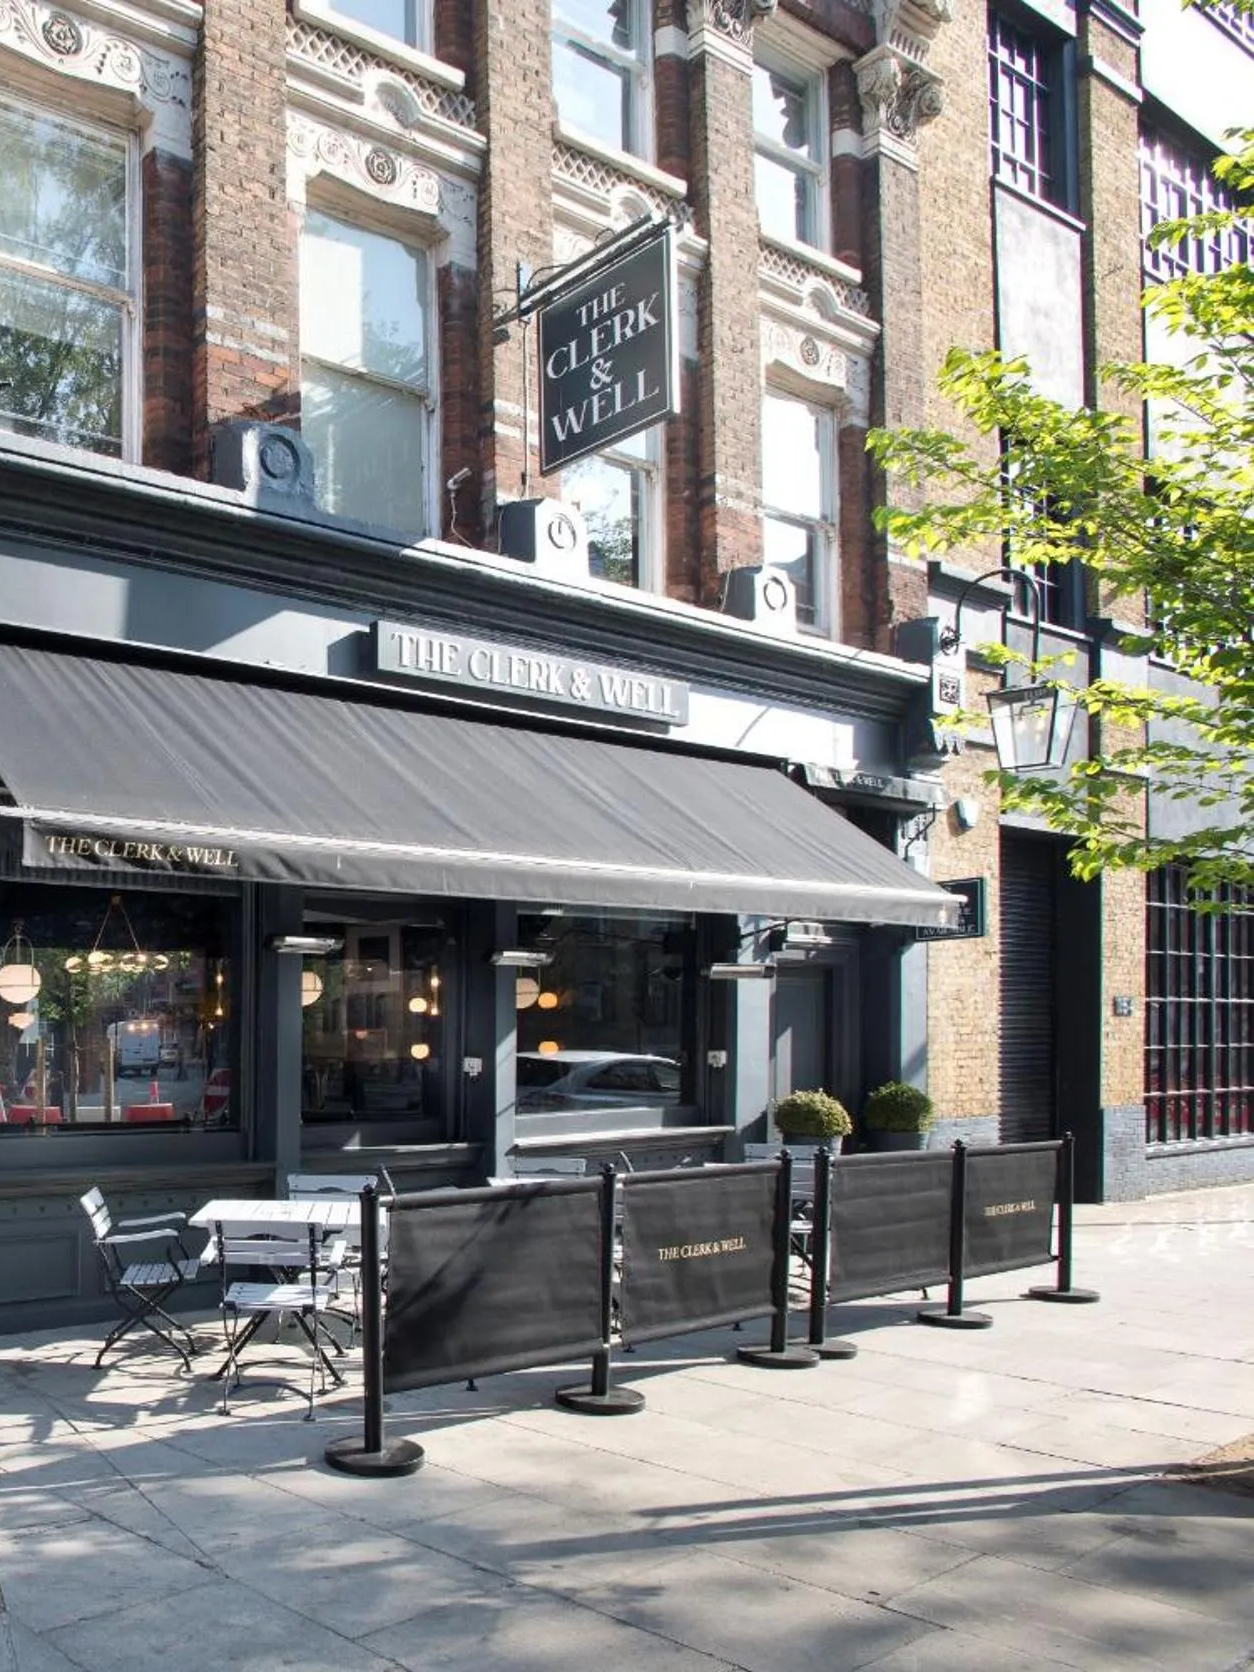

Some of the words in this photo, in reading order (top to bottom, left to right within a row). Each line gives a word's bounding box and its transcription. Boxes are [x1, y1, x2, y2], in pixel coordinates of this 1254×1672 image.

[577, 282, 625, 327] THE
[547, 292, 659, 379] CLERK
[590, 358, 613, 390] &
[552, 369, 659, 442] WELL
[391, 631, 461, 676] THE
[468, 650, 565, 697] CLERK
[570, 667, 591, 700] &
[598, 673, 680, 717] WELL
[46, 836, 91, 855] THE
[95, 839, 164, 861] CLERK
[166, 845, 183, 862] &
[186, 847, 239, 867] WELL
[658, 1247, 679, 1260] THE
[680, 1242, 712, 1258] CLERK
[720, 1236, 746, 1251] WELL
